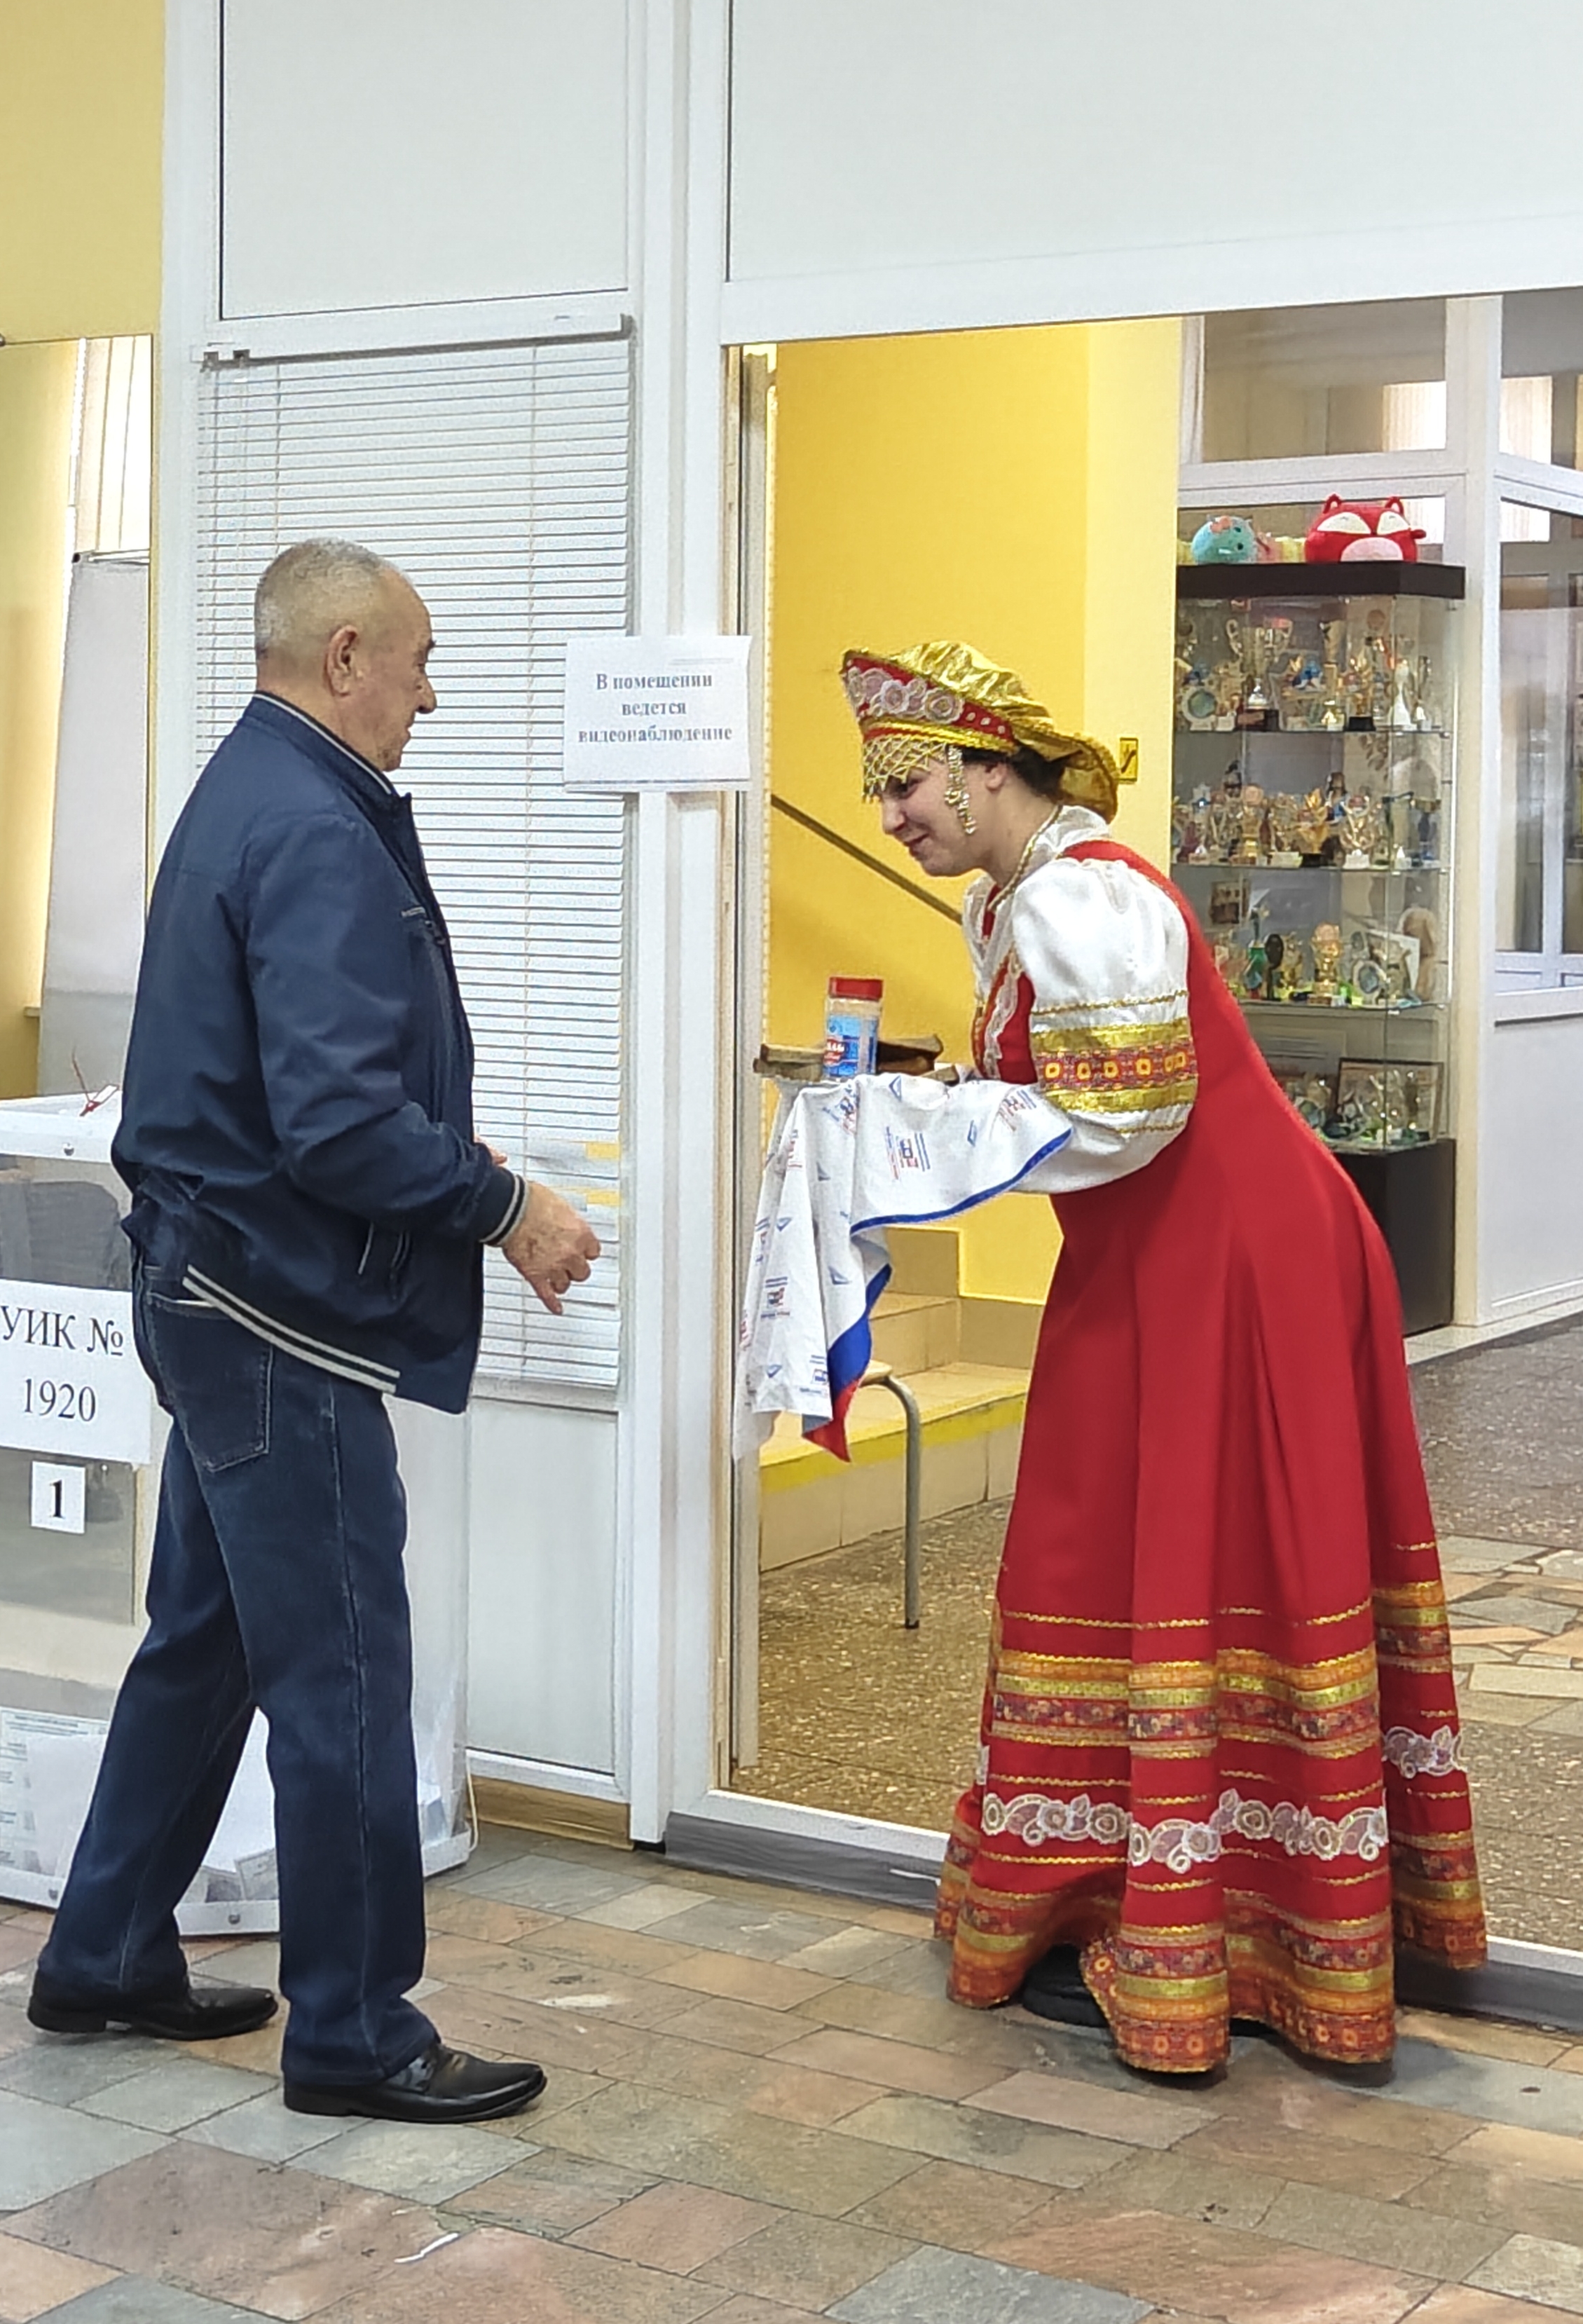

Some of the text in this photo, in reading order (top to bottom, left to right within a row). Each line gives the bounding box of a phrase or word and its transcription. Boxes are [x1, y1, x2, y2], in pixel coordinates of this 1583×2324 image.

[596, 674, 713, 690] В помещении
[622, 702, 687, 716] ведется
[578, 725, 733, 742] видеонаблюдение
[0, 1306, 124, 1356] УИК №
[23, 1378, 97, 1422] 1920
[49, 1479, 64, 1519] 1
